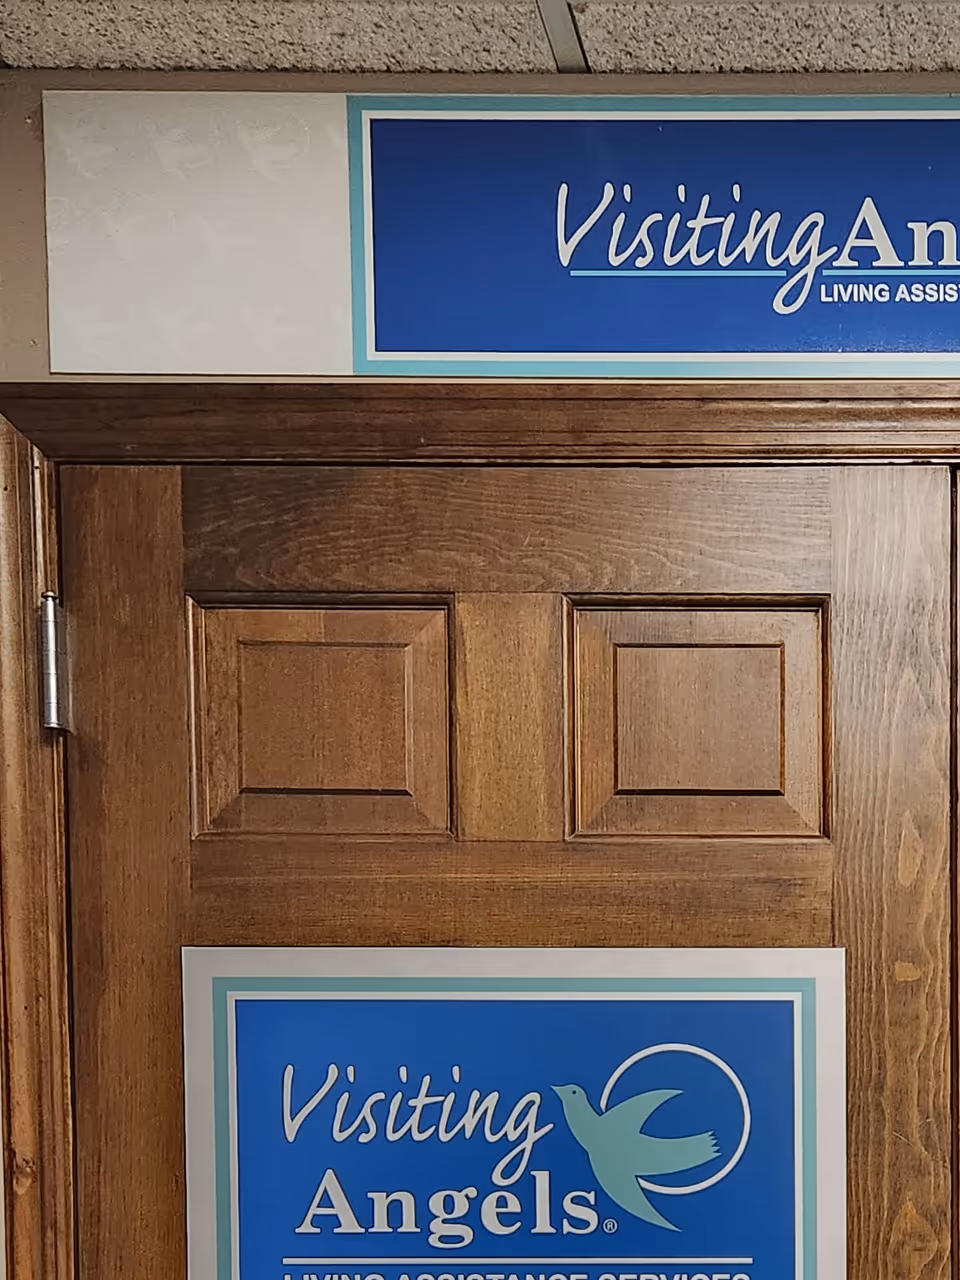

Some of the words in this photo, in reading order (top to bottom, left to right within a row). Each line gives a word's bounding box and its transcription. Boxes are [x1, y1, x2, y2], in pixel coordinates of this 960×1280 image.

[556, 182, 838, 314] Visiting
[820, 284, 890, 303] LIVING
[281, 1063, 554, 1186] Visiting
